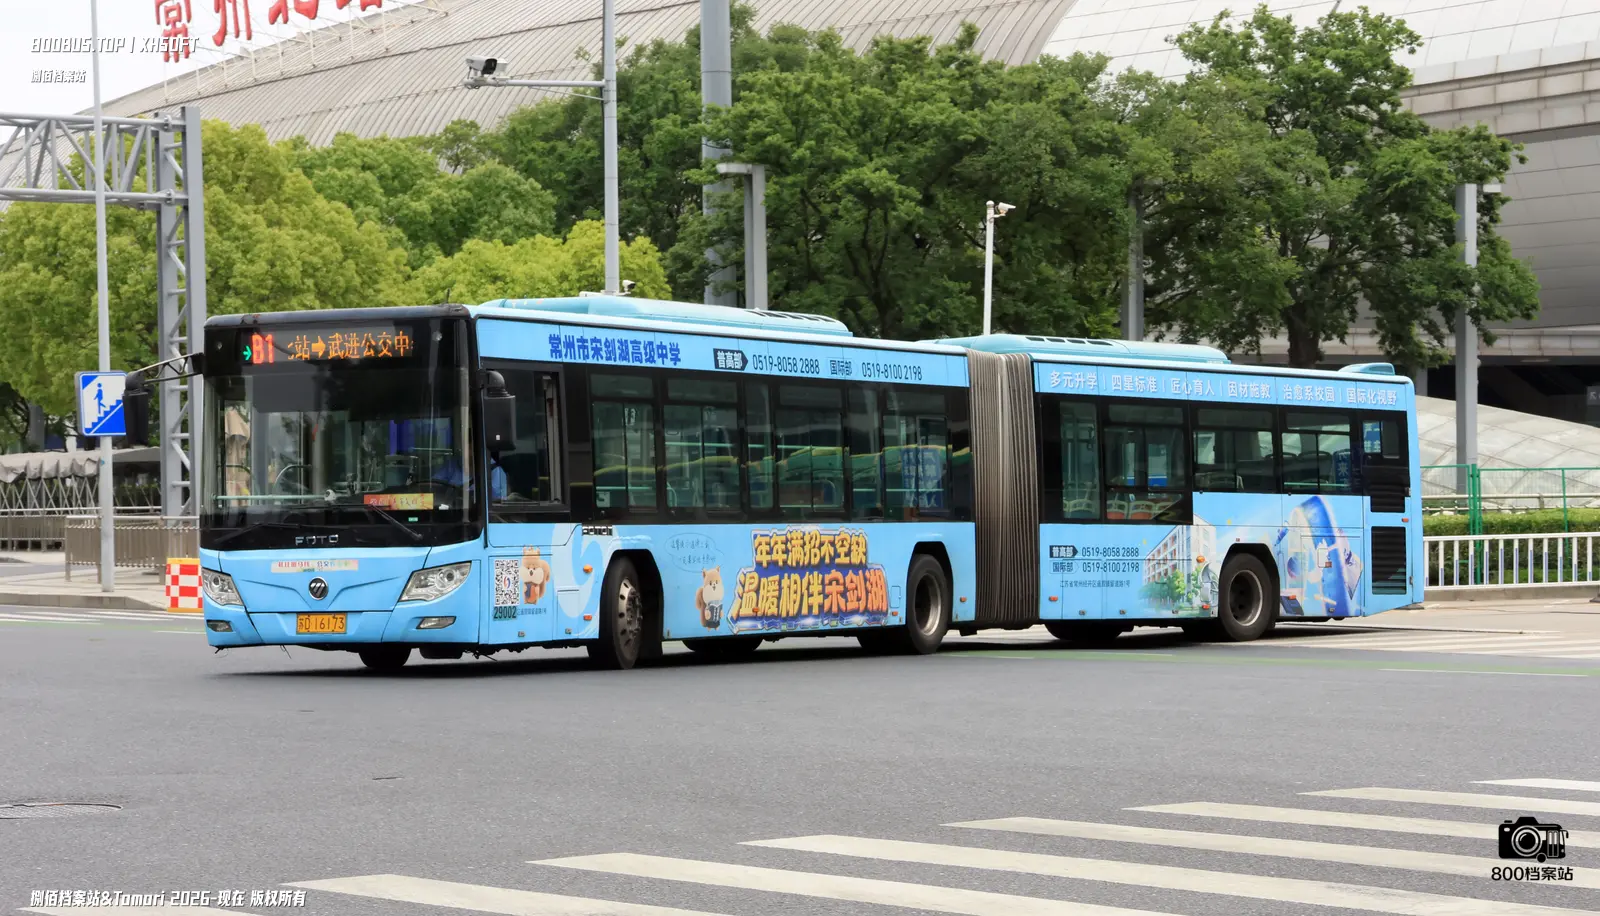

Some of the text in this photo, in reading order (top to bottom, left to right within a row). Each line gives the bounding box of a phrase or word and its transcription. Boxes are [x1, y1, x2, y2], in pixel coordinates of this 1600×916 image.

[154, 0, 382, 62] 常州
[251, 334, 274, 364] B1
[548, 333, 682, 366] 常州市宋剑湖高级中学
[716, 350, 923, 381] 普高部 0519-8058 2888 国际部 0519-8100 2198
[1050, 370, 1397, 406] 多元升学 四星标准 匠心育人 因材施教 治愈系校园 国际化视野
[753, 529, 868, 568] 年年满招不空缺
[1052, 546, 1140, 557] 普高部 0519-8058 2888
[1052, 561, 1140, 573] 国际部 0519-8100 2198
[731, 569, 888, 618] 温暖相伴宋剑湖
[493, 605, 518, 619] 29002
